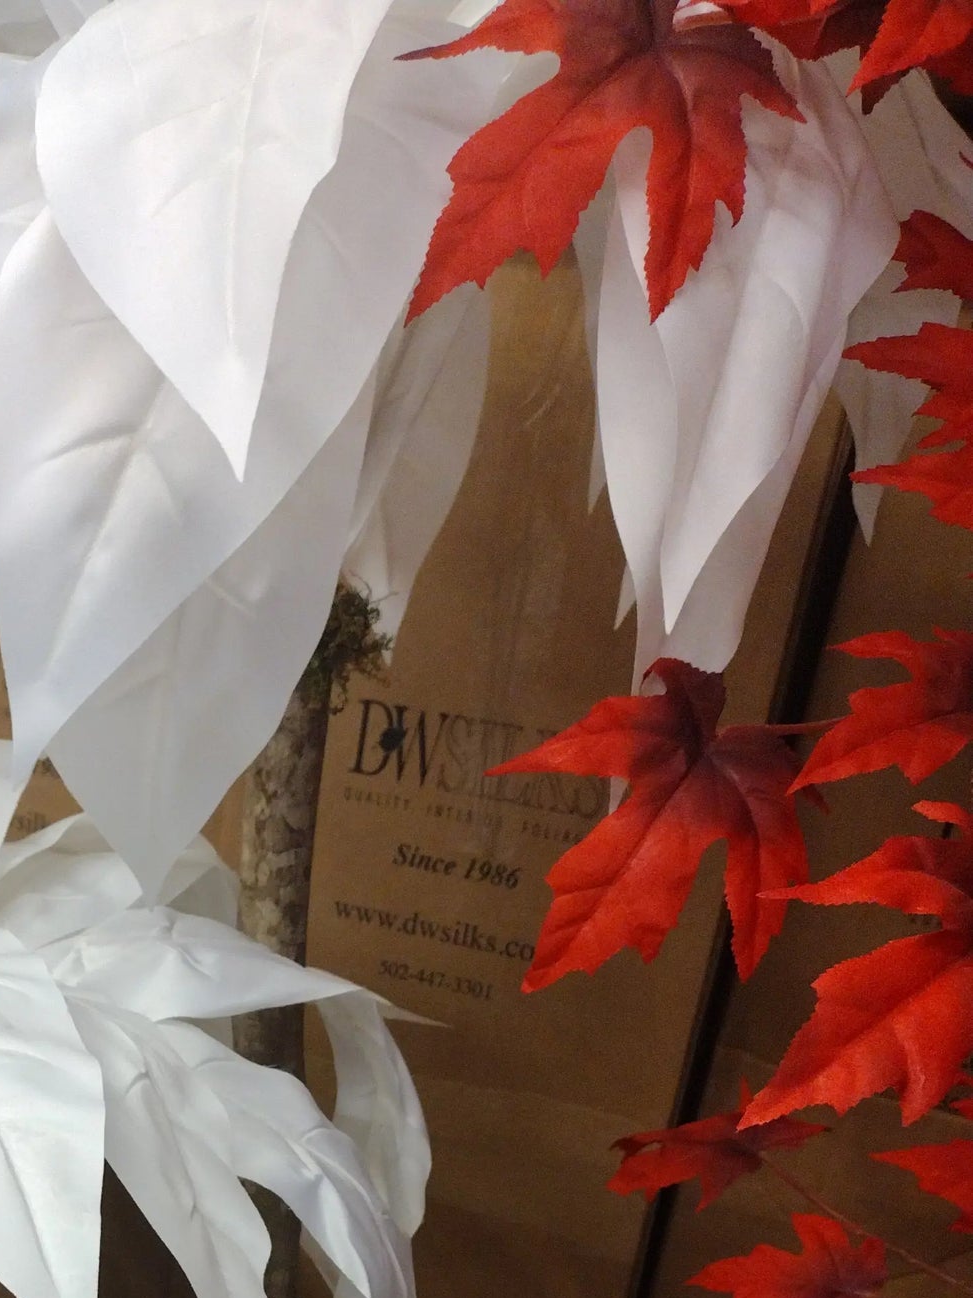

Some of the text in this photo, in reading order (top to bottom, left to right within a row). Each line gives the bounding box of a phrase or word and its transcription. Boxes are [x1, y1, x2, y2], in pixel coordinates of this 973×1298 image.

[392, 842, 521, 891] Since 1986
[335, 899, 535, 963] www.dwsilks.co
[379, 958, 493, 1001] 502-447-3301
